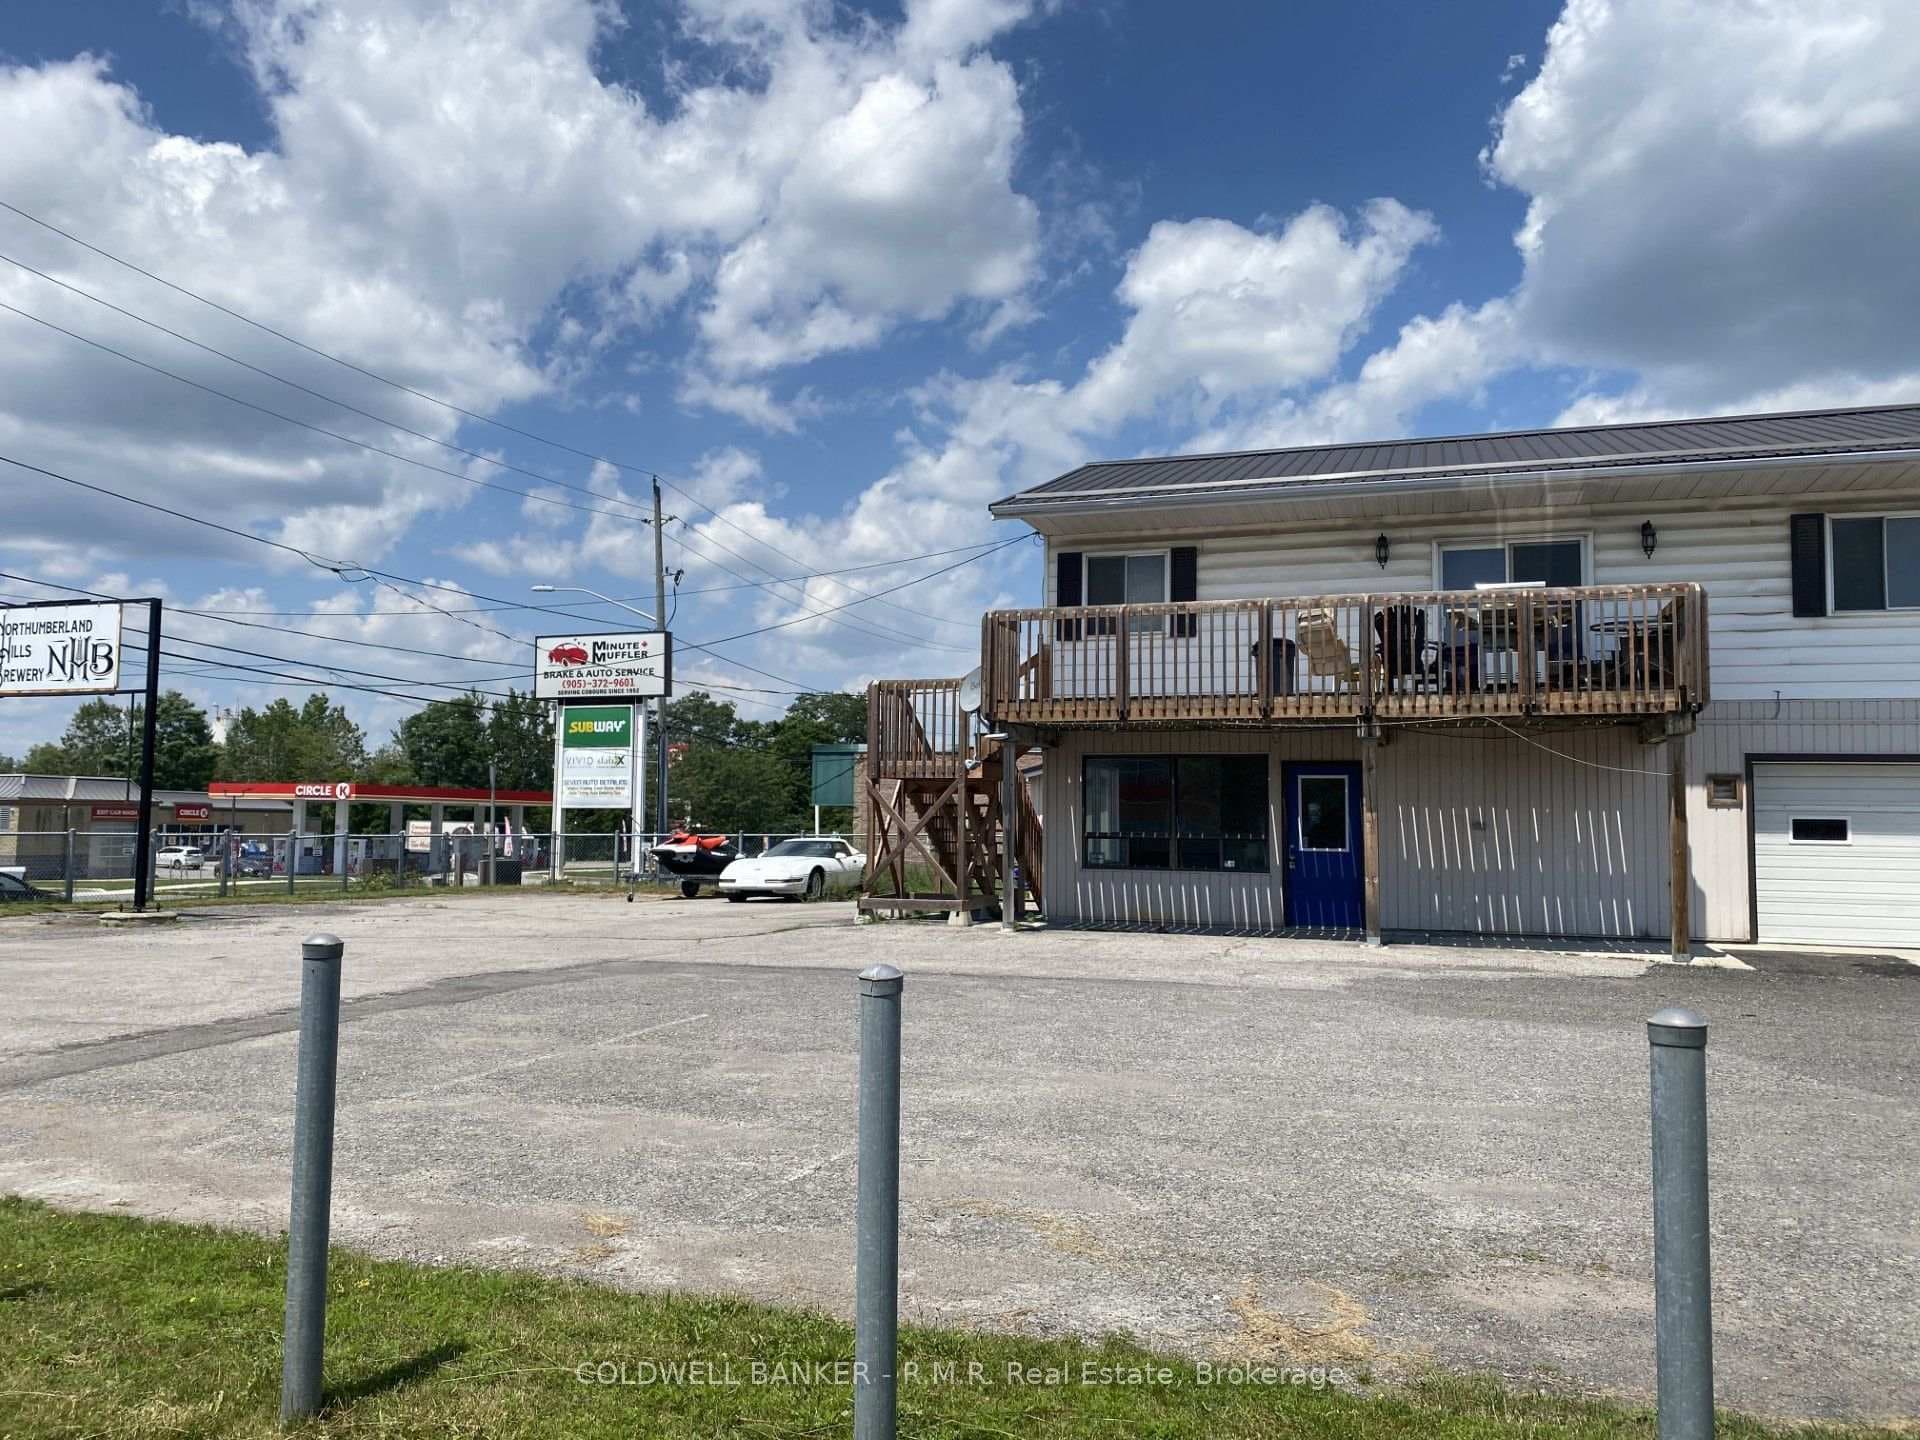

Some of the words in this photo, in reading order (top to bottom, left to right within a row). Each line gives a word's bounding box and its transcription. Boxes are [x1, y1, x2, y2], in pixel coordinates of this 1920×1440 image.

[592, 641, 640, 651] MINUTE
[592, 650, 648, 664] MUFFLER
[0, 667, 45, 686] REWERY
[543, 670, 574, 679] BRAKE
[576, 670, 584, 678] &
[586, 669, 613, 678] AUTO
[615, 667, 655, 677] SERVICE
[568, 720, 626, 734] SUBWAY
[295, 785, 333, 796] CIRCLE
[179, 808, 200, 816] CIRCLE
